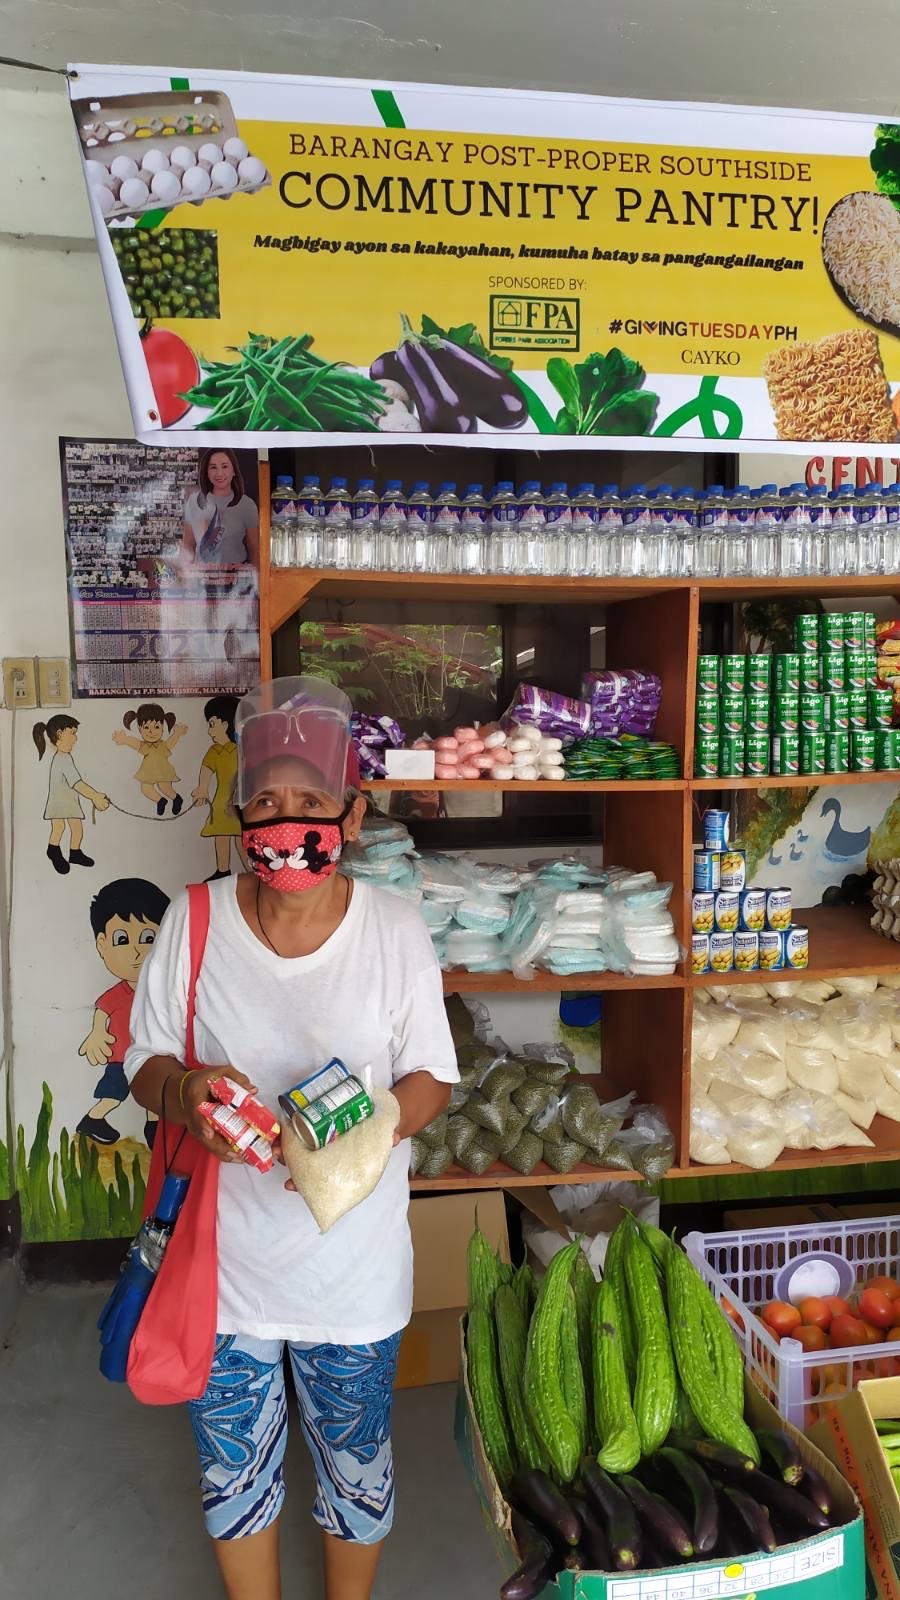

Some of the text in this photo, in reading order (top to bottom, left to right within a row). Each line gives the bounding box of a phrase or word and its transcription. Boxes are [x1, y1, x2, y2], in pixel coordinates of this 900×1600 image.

[289, 133, 812, 182] BARANGAY POST-PROPER SOUTHSIDE
[279, 170, 819, 235] COMMUNITY PANTRY!
[253, 234, 804, 272] Magbigay ayon sa kakayahan, kumuha batay sa pangangailangan
[488, 276, 587, 291] SPONSORED BY:
[526, 302, 574, 329] FPA
[681, 349, 741, 366] CAYKO
[88, 688, 131, 696] BARANGAY
[698, 700, 716, 710] Ligo
[725, 700, 742, 708] Ligo
[751, 699, 768, 708] Ligo
[802, 698, 820, 706] Ligo
[836, 696, 848, 706] Lig
[748, 740, 766, 748] Ligo
[856, 736, 874, 744] Ligo
[800, 1546, 836, 1571] SIZE
